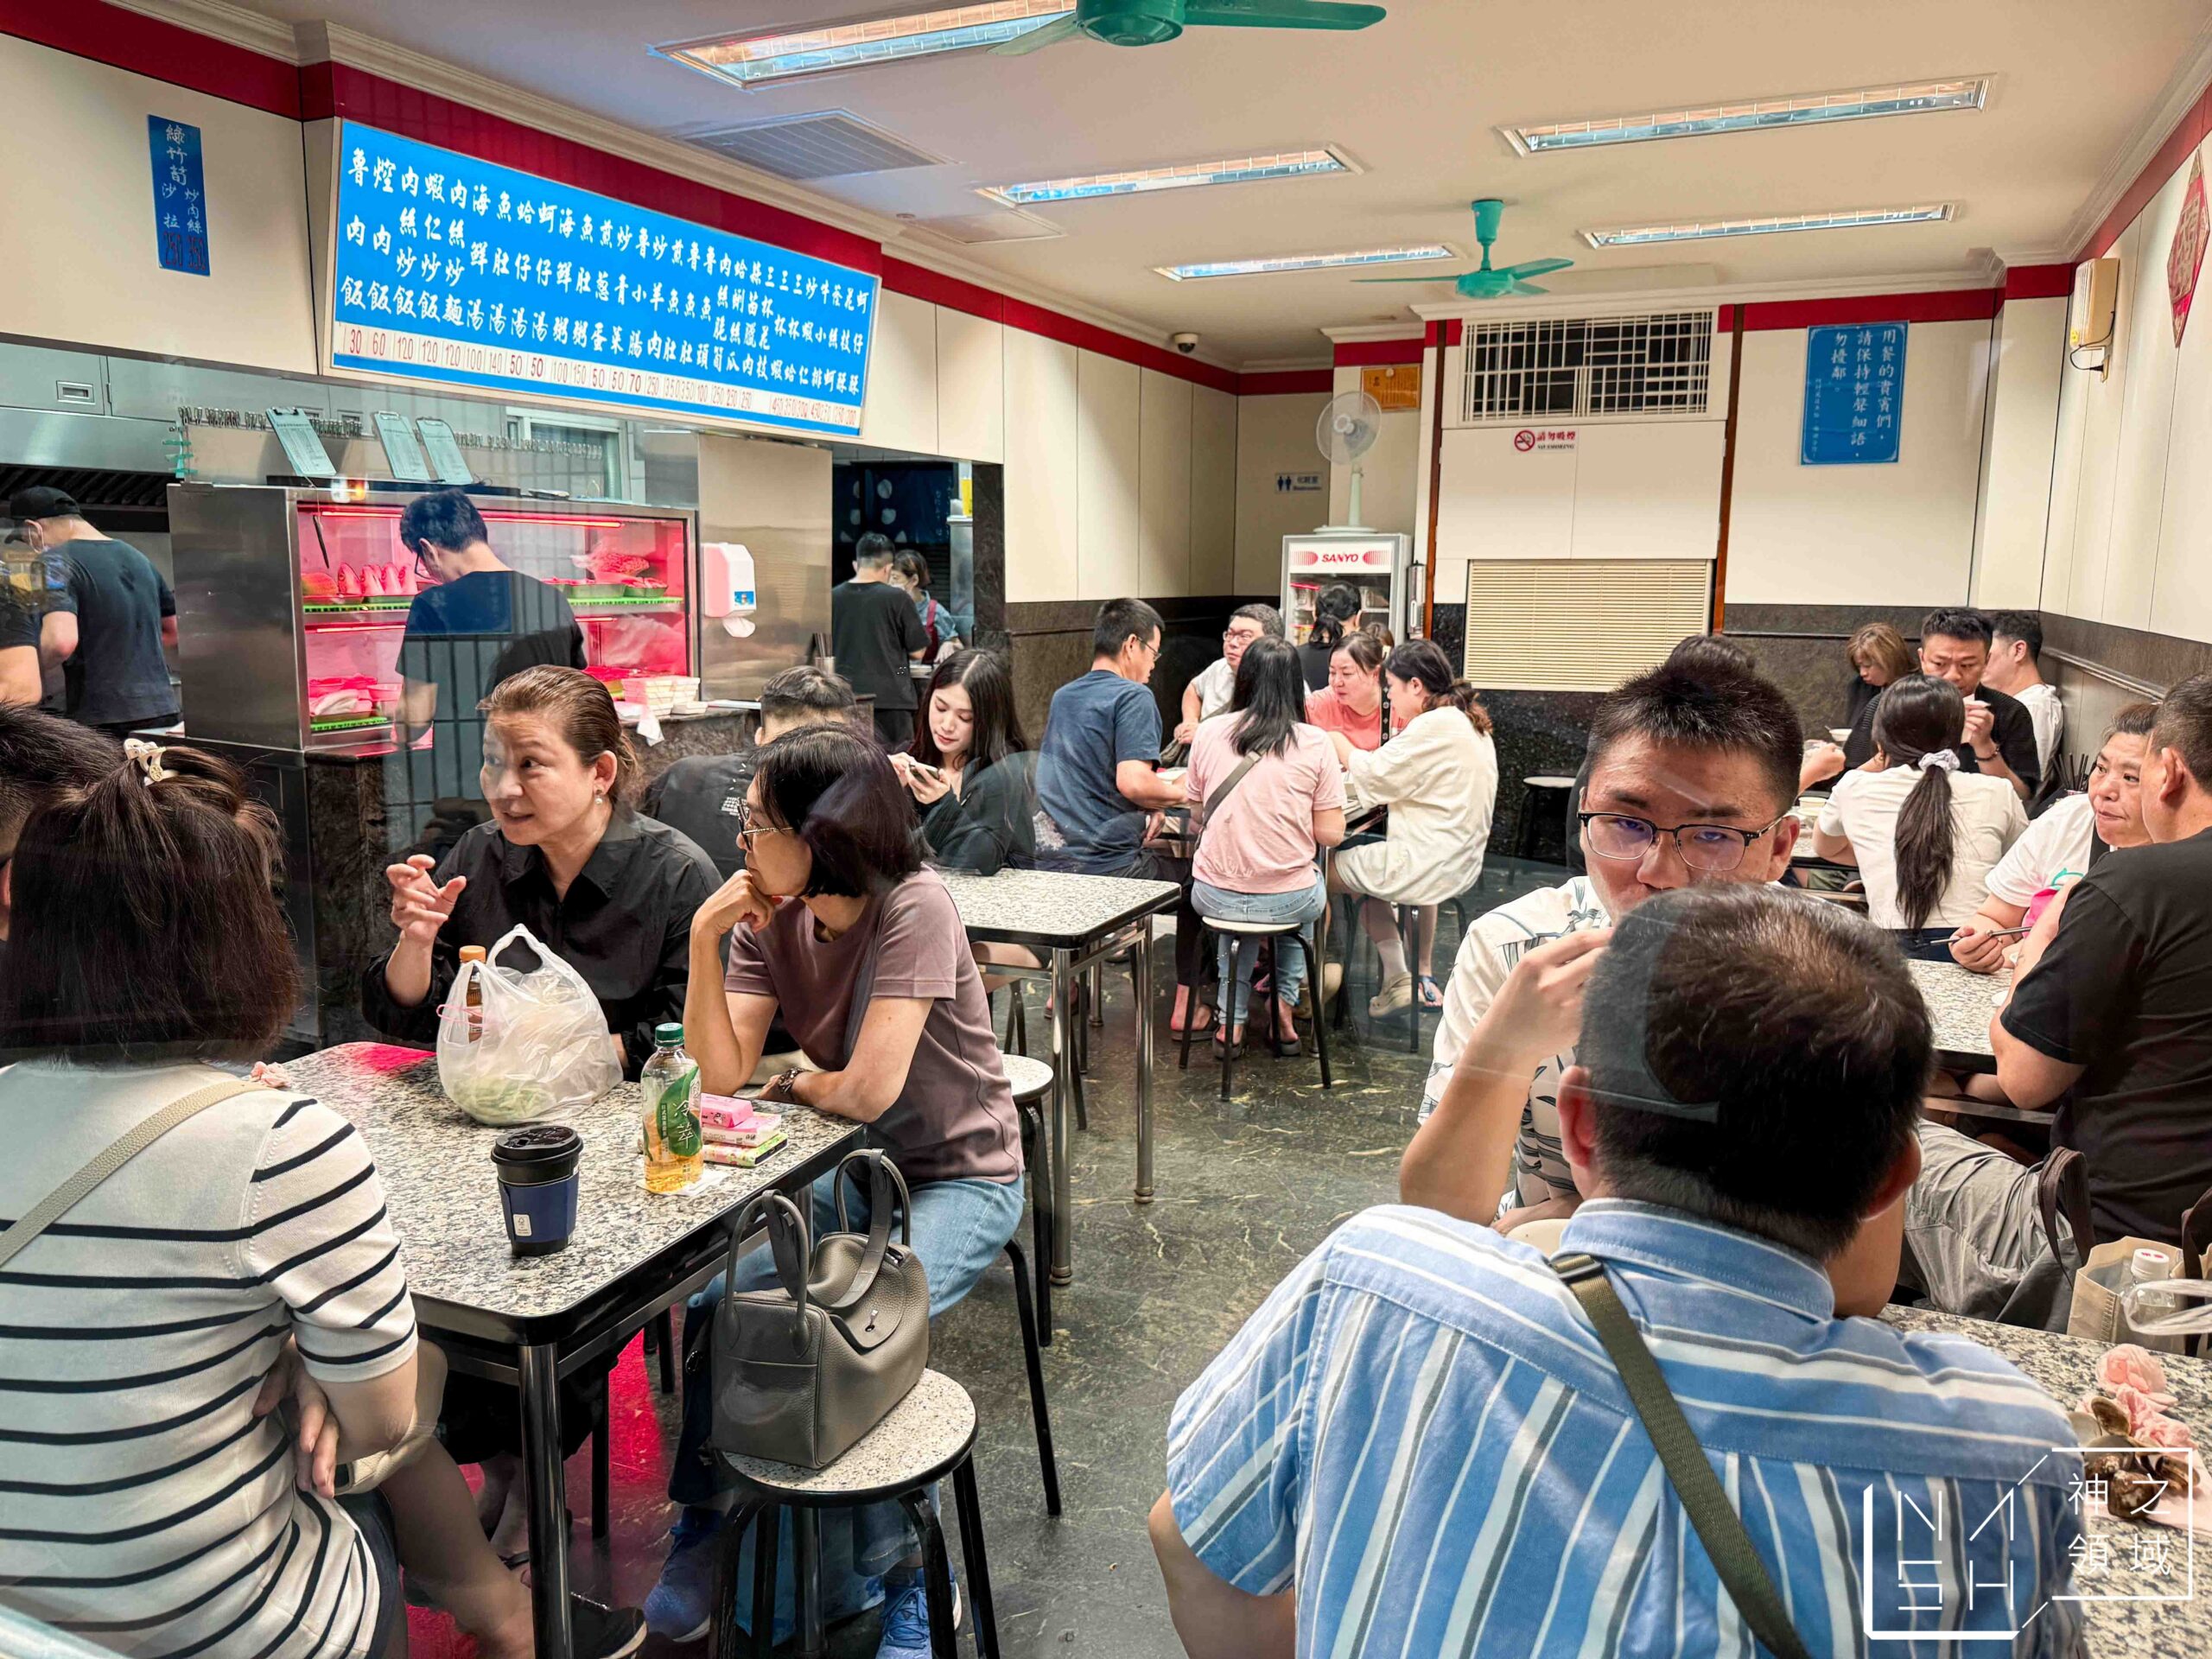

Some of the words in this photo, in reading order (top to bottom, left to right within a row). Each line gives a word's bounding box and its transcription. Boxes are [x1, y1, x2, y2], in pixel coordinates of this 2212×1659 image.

[162, 182, 181, 229] 沙拉
[165, 124, 188, 186] 綠竹筍
[341, 149, 368, 308] 魯肉飯
[393, 167, 418, 317] 肉絲炒飯
[418, 174, 444, 321] 蝦仁炒飯
[442, 180, 467, 326] 肉絲炒麵
[467, 185, 490, 330] 海鮮湯
[490, 192, 511, 334] 魚肚湯
[512, 201, 535, 338] 蛤仔湯
[532, 203, 557, 341] 蚵仔湯
[553, 208, 575, 344] 海鮮粥
[573, 214, 593, 347] 魚肚粥
[611, 226, 632, 353] 炒青菜
[628, 228, 650, 358] 魯小腸
[349, 328, 361, 353] 30
[372, 332, 385, 357] 60
[397, 336, 414, 361] 120
[421, 340, 438, 365] 120
[444, 343, 461, 367] 120
[466, 346, 482, 371] 100
[509, 353, 523, 377] 50
[531, 357, 543, 379] 50
[553, 360, 568, 383] 100
[592, 366, 605, 388] 50
[612, 370, 624, 391] 50
[629, 372, 641, 393] 70
[646, 375, 659, 396] 250
[648, 235, 667, 359] 炒羊肉
[664, 240, 683, 360] 煎魚肚
[680, 242, 700, 364] 魯魚肚
[697, 246, 716, 369] 魯魚頭
[757, 267, 774, 380] 三杯花枝
[1321, 553, 1359, 563] SANYO
